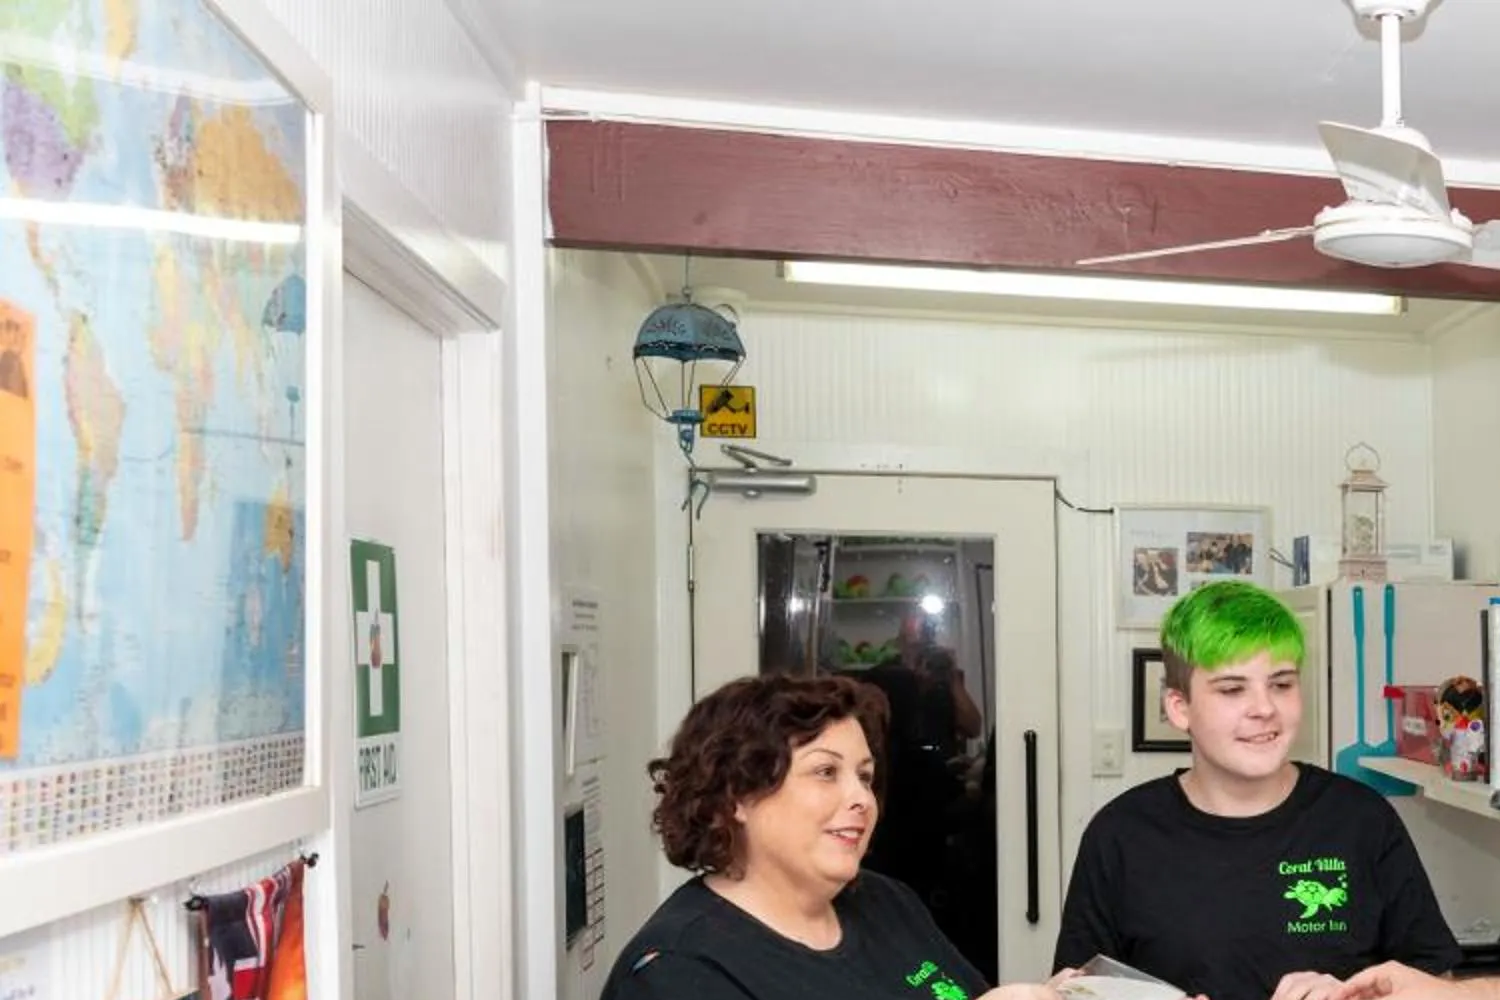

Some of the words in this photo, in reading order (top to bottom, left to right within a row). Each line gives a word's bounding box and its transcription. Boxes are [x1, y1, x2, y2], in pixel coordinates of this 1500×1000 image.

[707, 424, 748, 435] CCTV
[1279, 860, 1312, 875] Coral
[1314, 857, 1346, 871] Villa
[1287, 921, 1326, 934] Motor
[1330, 919, 1347, 932] Inn
